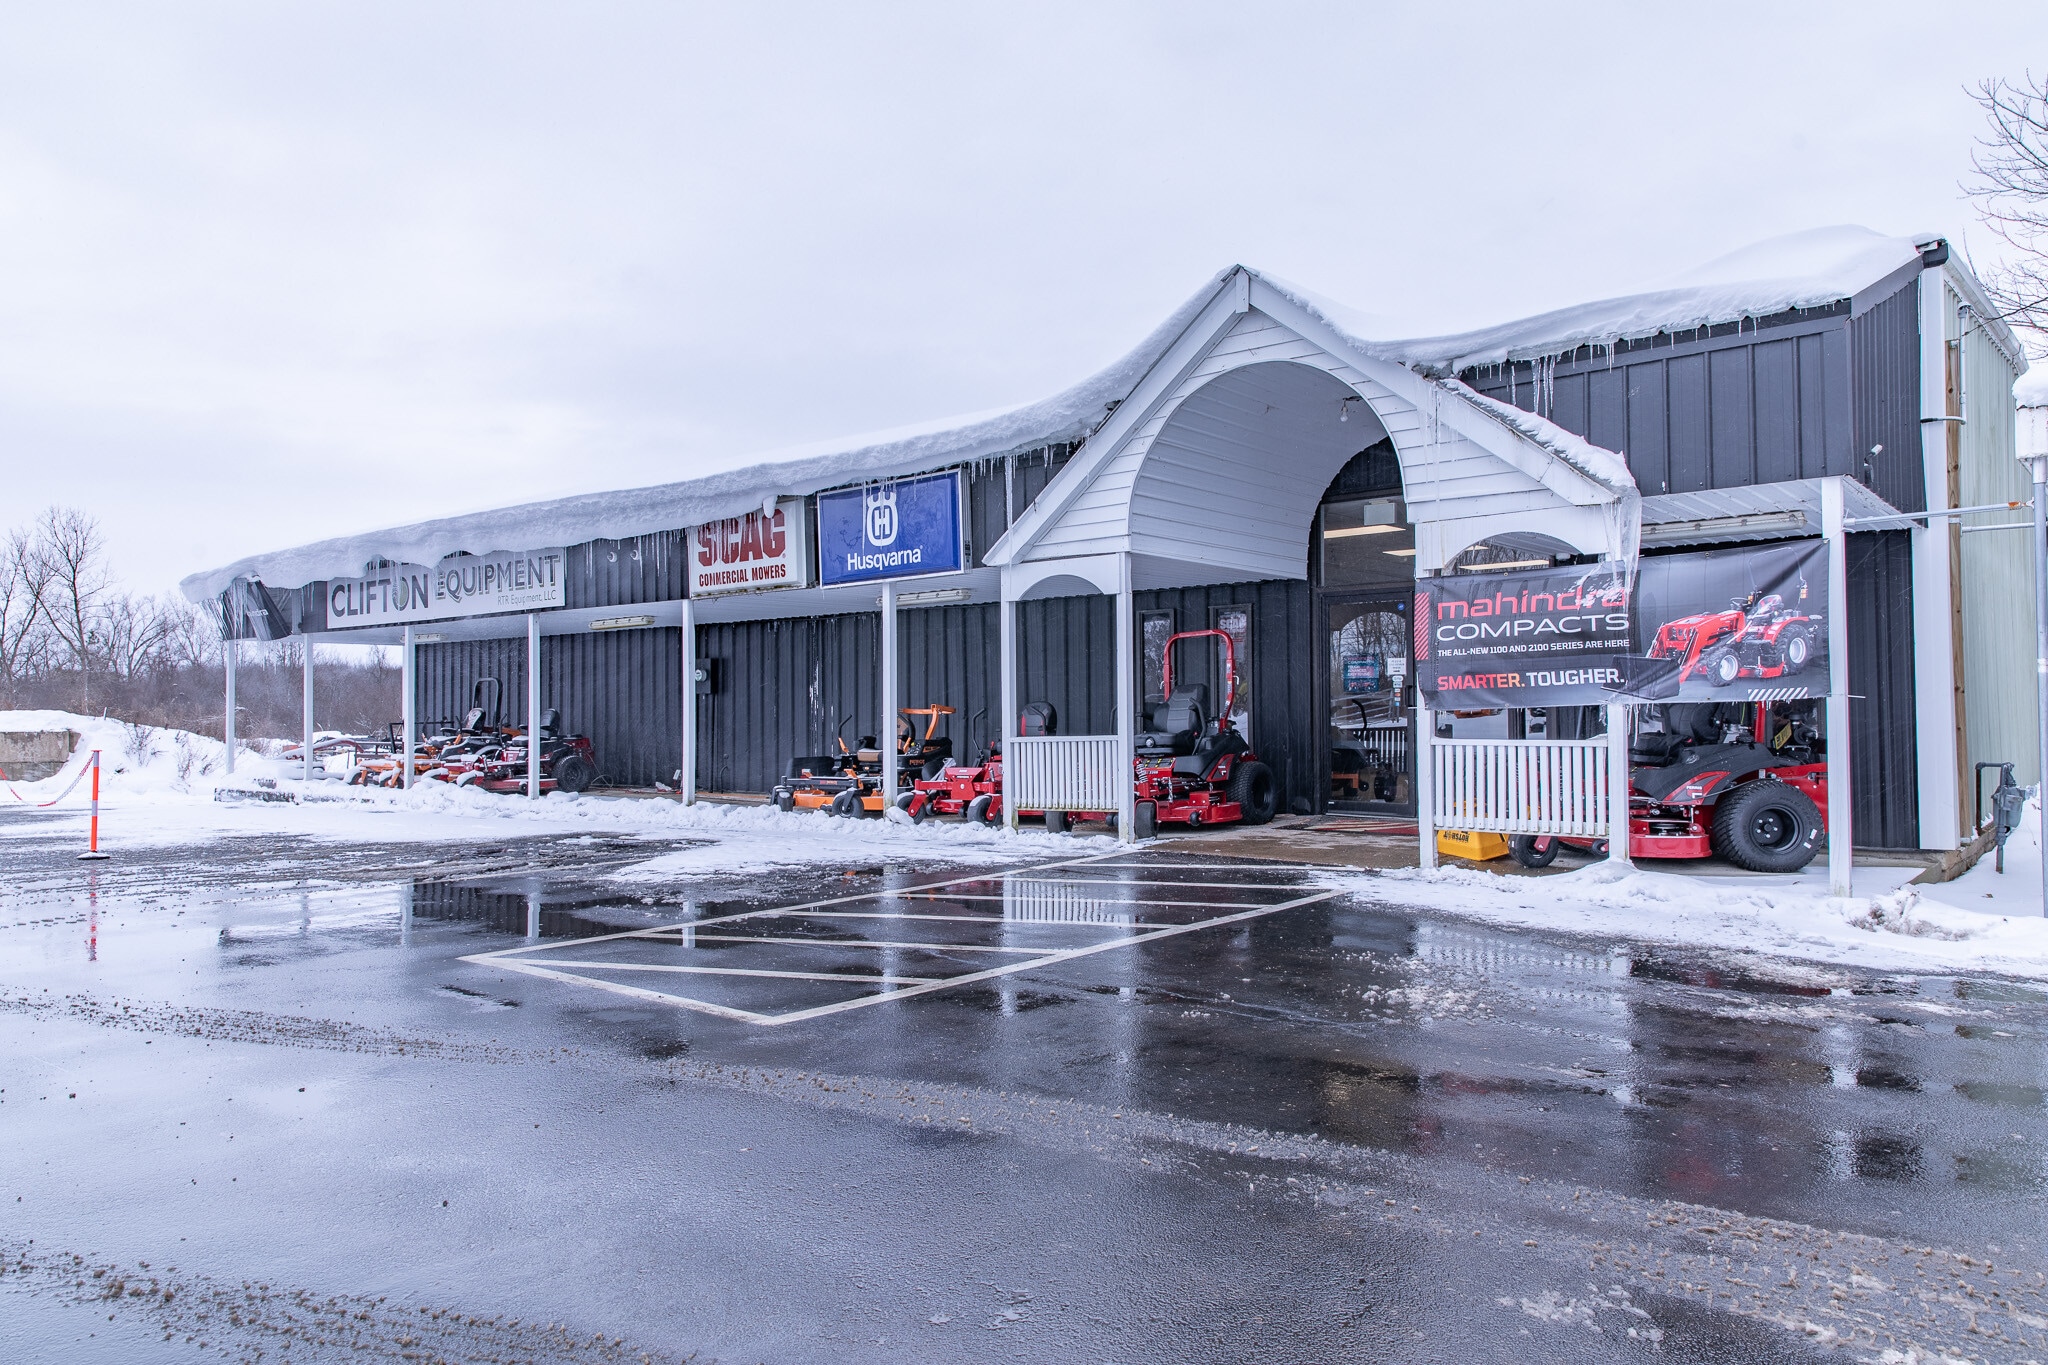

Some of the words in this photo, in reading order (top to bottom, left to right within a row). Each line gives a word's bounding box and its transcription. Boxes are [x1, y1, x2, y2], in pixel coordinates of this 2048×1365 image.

[698, 509, 786, 567] SCAG
[847, 548, 922, 571] Husqvarna
[332, 573, 429, 617] CLIFTON
[436, 554, 561, 603] EQUIPMENT
[699, 568, 749, 587] COMMERCIAL
[751, 563, 786, 581] MOWERS
[511, 593, 543, 606] Equpment,
[544, 590, 557, 601] LLC
[1436, 613, 1630, 642] COMPACTS
[1438, 649, 1452, 657] THE
[1453, 646, 1489, 656] ALL-NEW
[1490, 645, 1508, 654] 1100
[1509, 644, 1527, 653] AND
[1528, 643, 1549, 652] 2100
[1550, 641, 1584, 650] SERIES
[1585, 640, 1603, 648] ARE
[1605, 639, 1631, 648] HERE
[1437, 673, 1526, 691] SMARTER.
[1526, 668, 1626, 687] TOUGHER.
